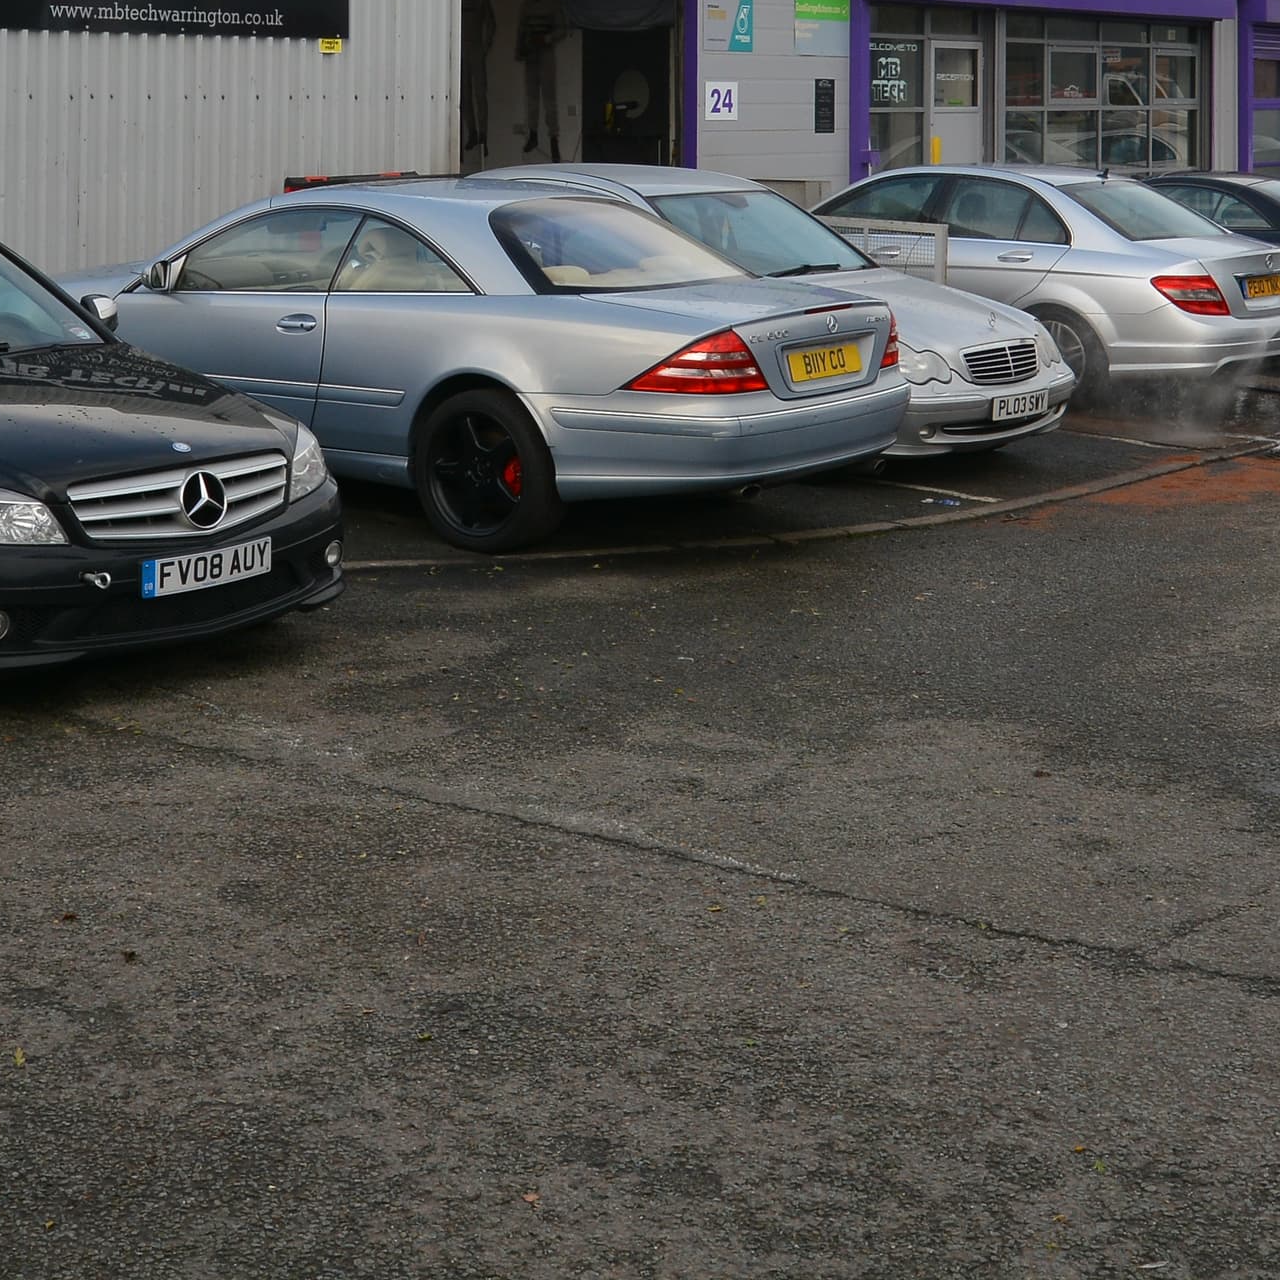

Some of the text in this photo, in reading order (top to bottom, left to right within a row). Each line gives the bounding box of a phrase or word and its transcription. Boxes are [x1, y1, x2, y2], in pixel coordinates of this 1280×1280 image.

[50, 2, 284, 28] www.mbtechwarrington.co.uk
[878, 57, 900, 78] MB
[710, 89, 733, 113] 24
[872, 80, 907, 103] TECH
[998, 397, 1027, 417] PL03
[159, 541, 270, 589] FV08 AUY
